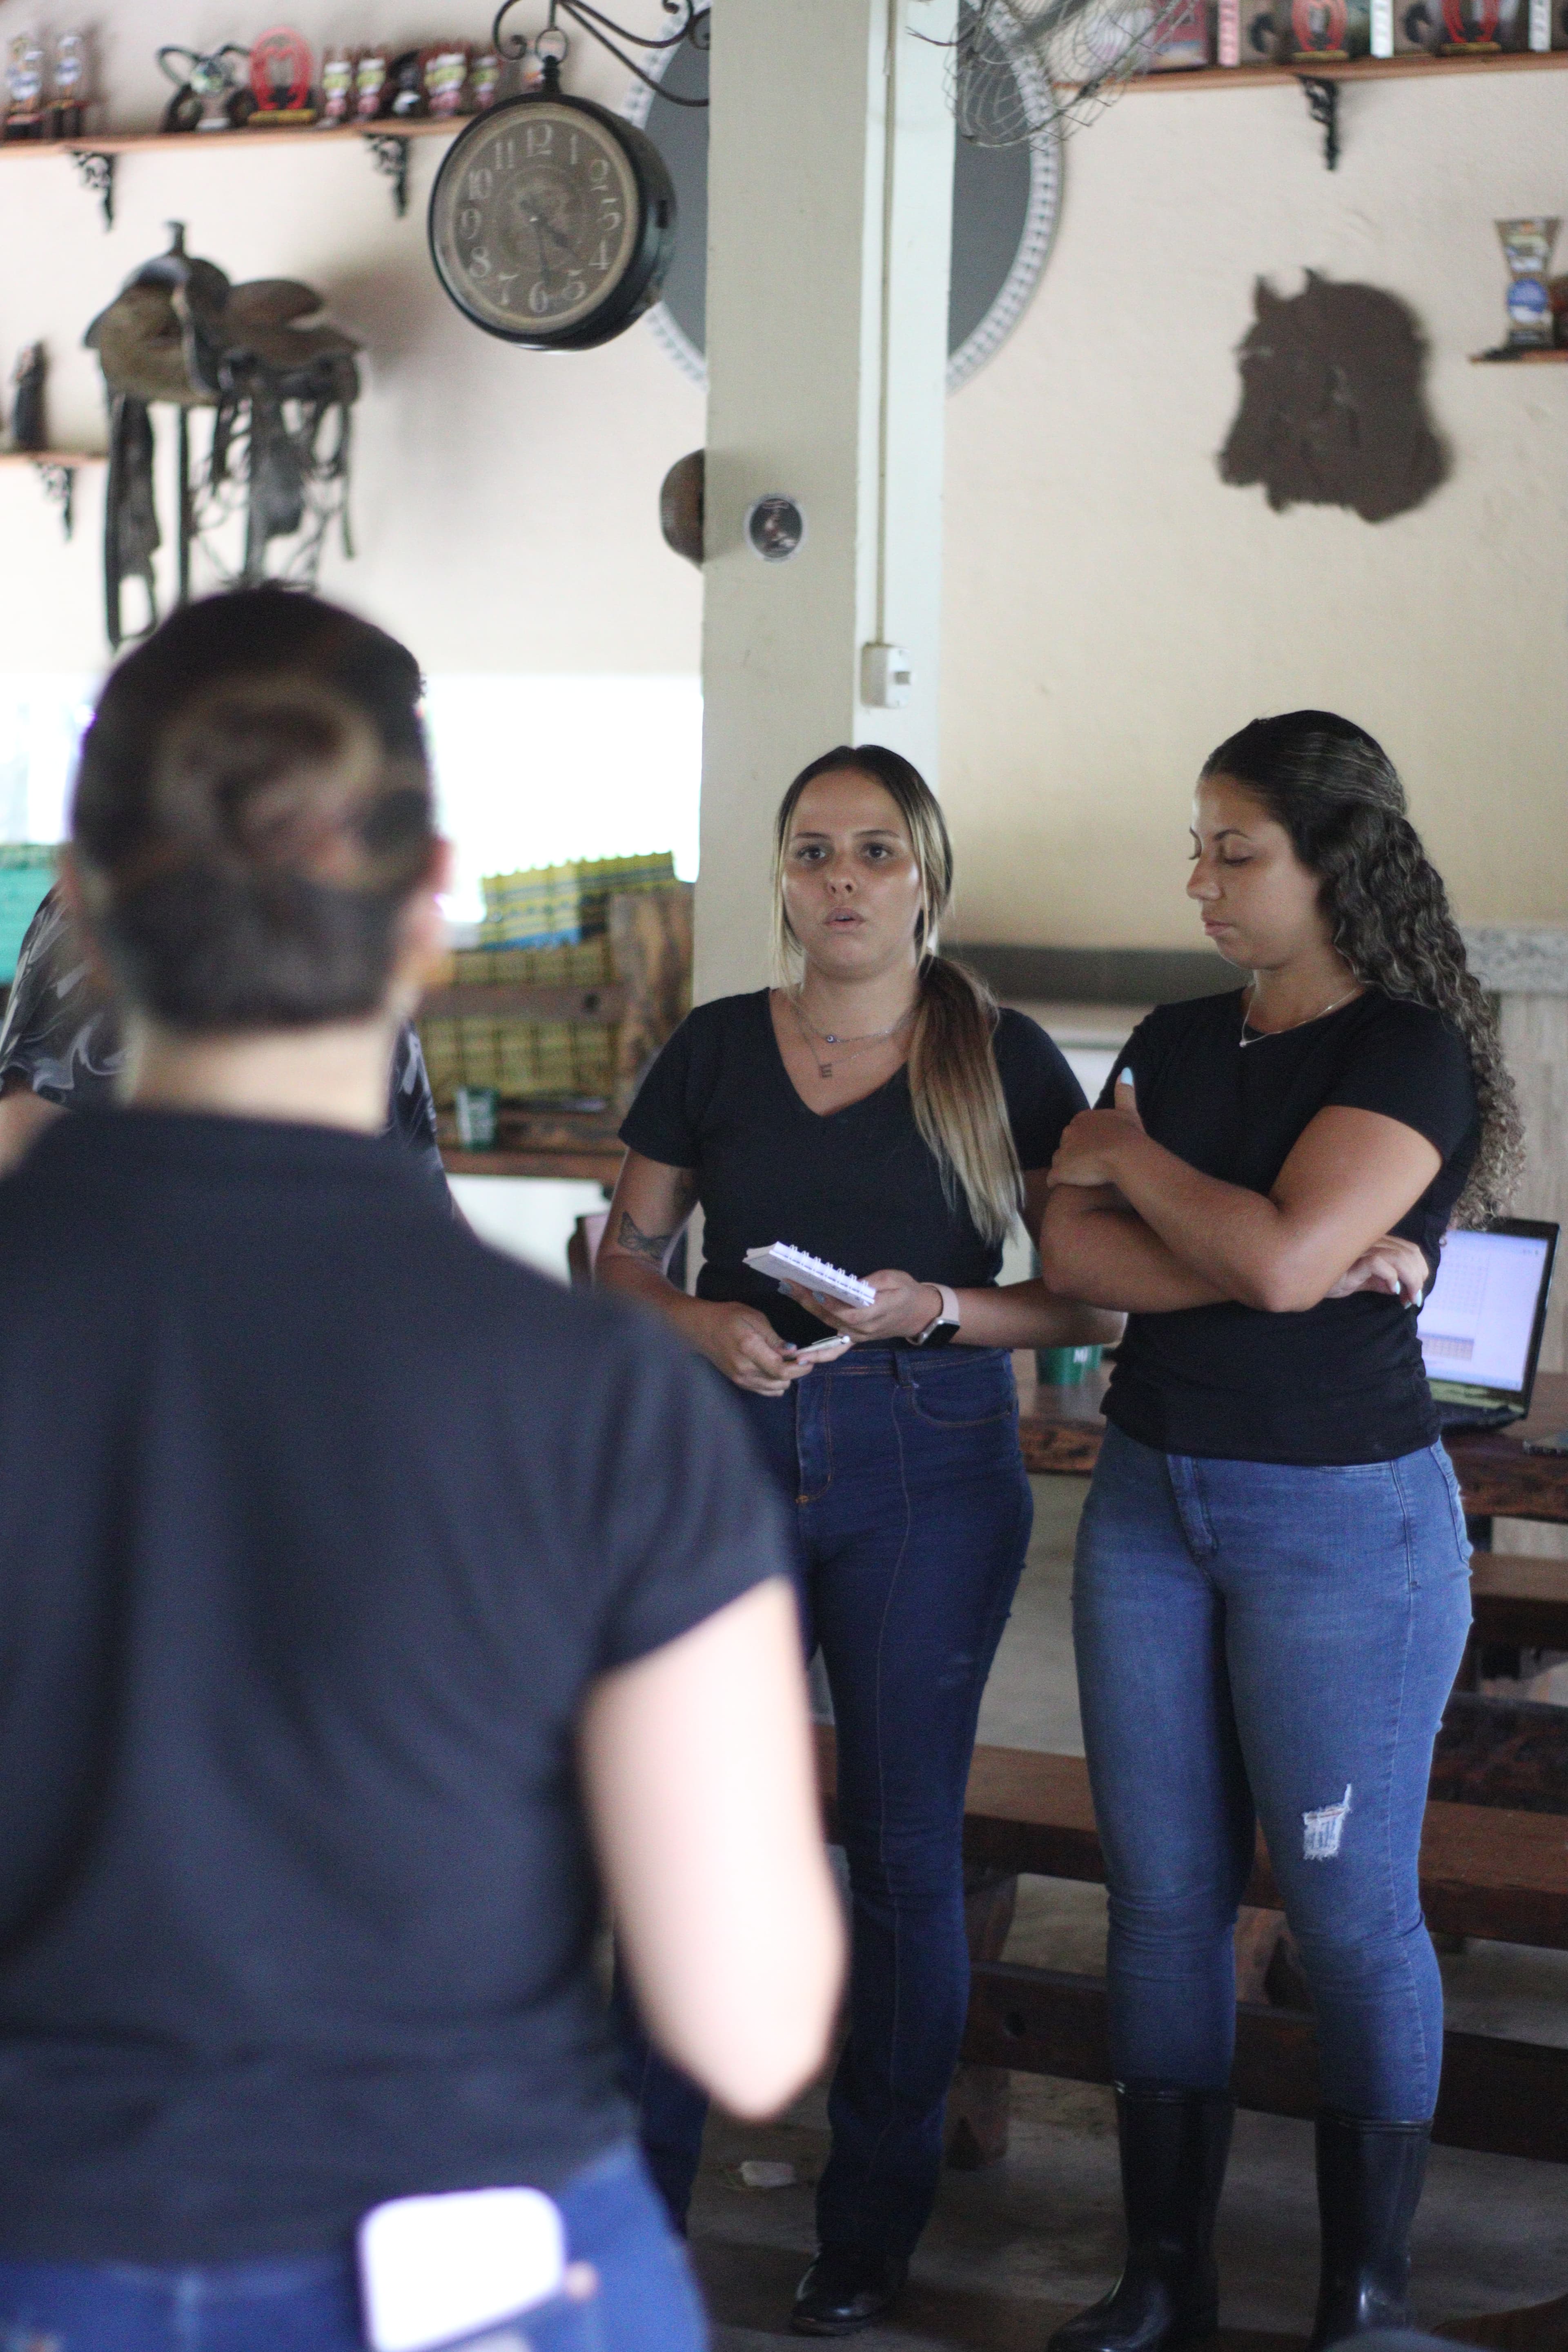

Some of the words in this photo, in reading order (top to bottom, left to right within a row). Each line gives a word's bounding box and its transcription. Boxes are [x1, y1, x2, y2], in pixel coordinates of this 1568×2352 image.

[495, 140, 515, 169] 11
[527, 124, 553, 158] 12
[570, 135, 580, 165] 1
[590, 159, 610, 191] 2
[461, 207, 482, 240] 9
[598, 198, 621, 232] 3
[469, 247, 490, 278] 8
[588, 240, 611, 270] 4
[499, 272, 520, 305] 7
[530, 282, 548, 314] 6
[561, 269, 586, 301] 5
